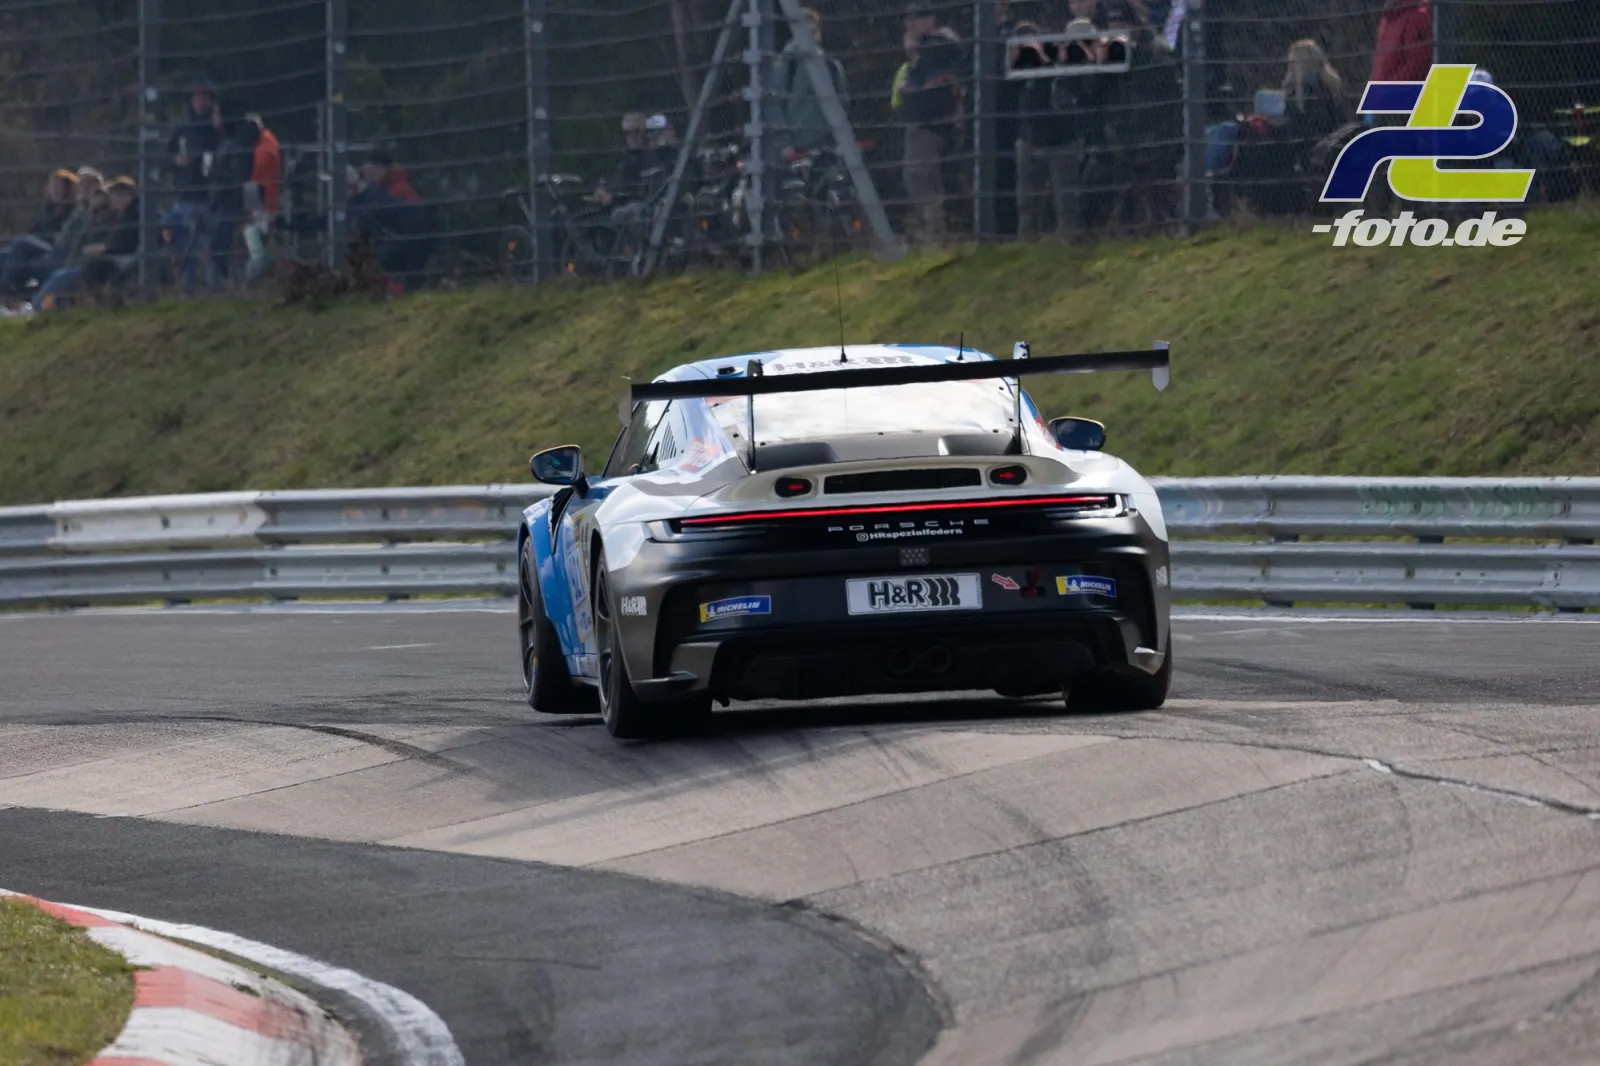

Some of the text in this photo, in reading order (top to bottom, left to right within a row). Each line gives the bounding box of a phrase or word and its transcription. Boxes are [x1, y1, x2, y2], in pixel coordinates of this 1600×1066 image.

[828, 518, 989, 532] PORSCHE
[1080, 581, 1111, 591] MICHELIN
[868, 580, 930, 608] H&R
[716, 601, 761, 614] MICHELIN
